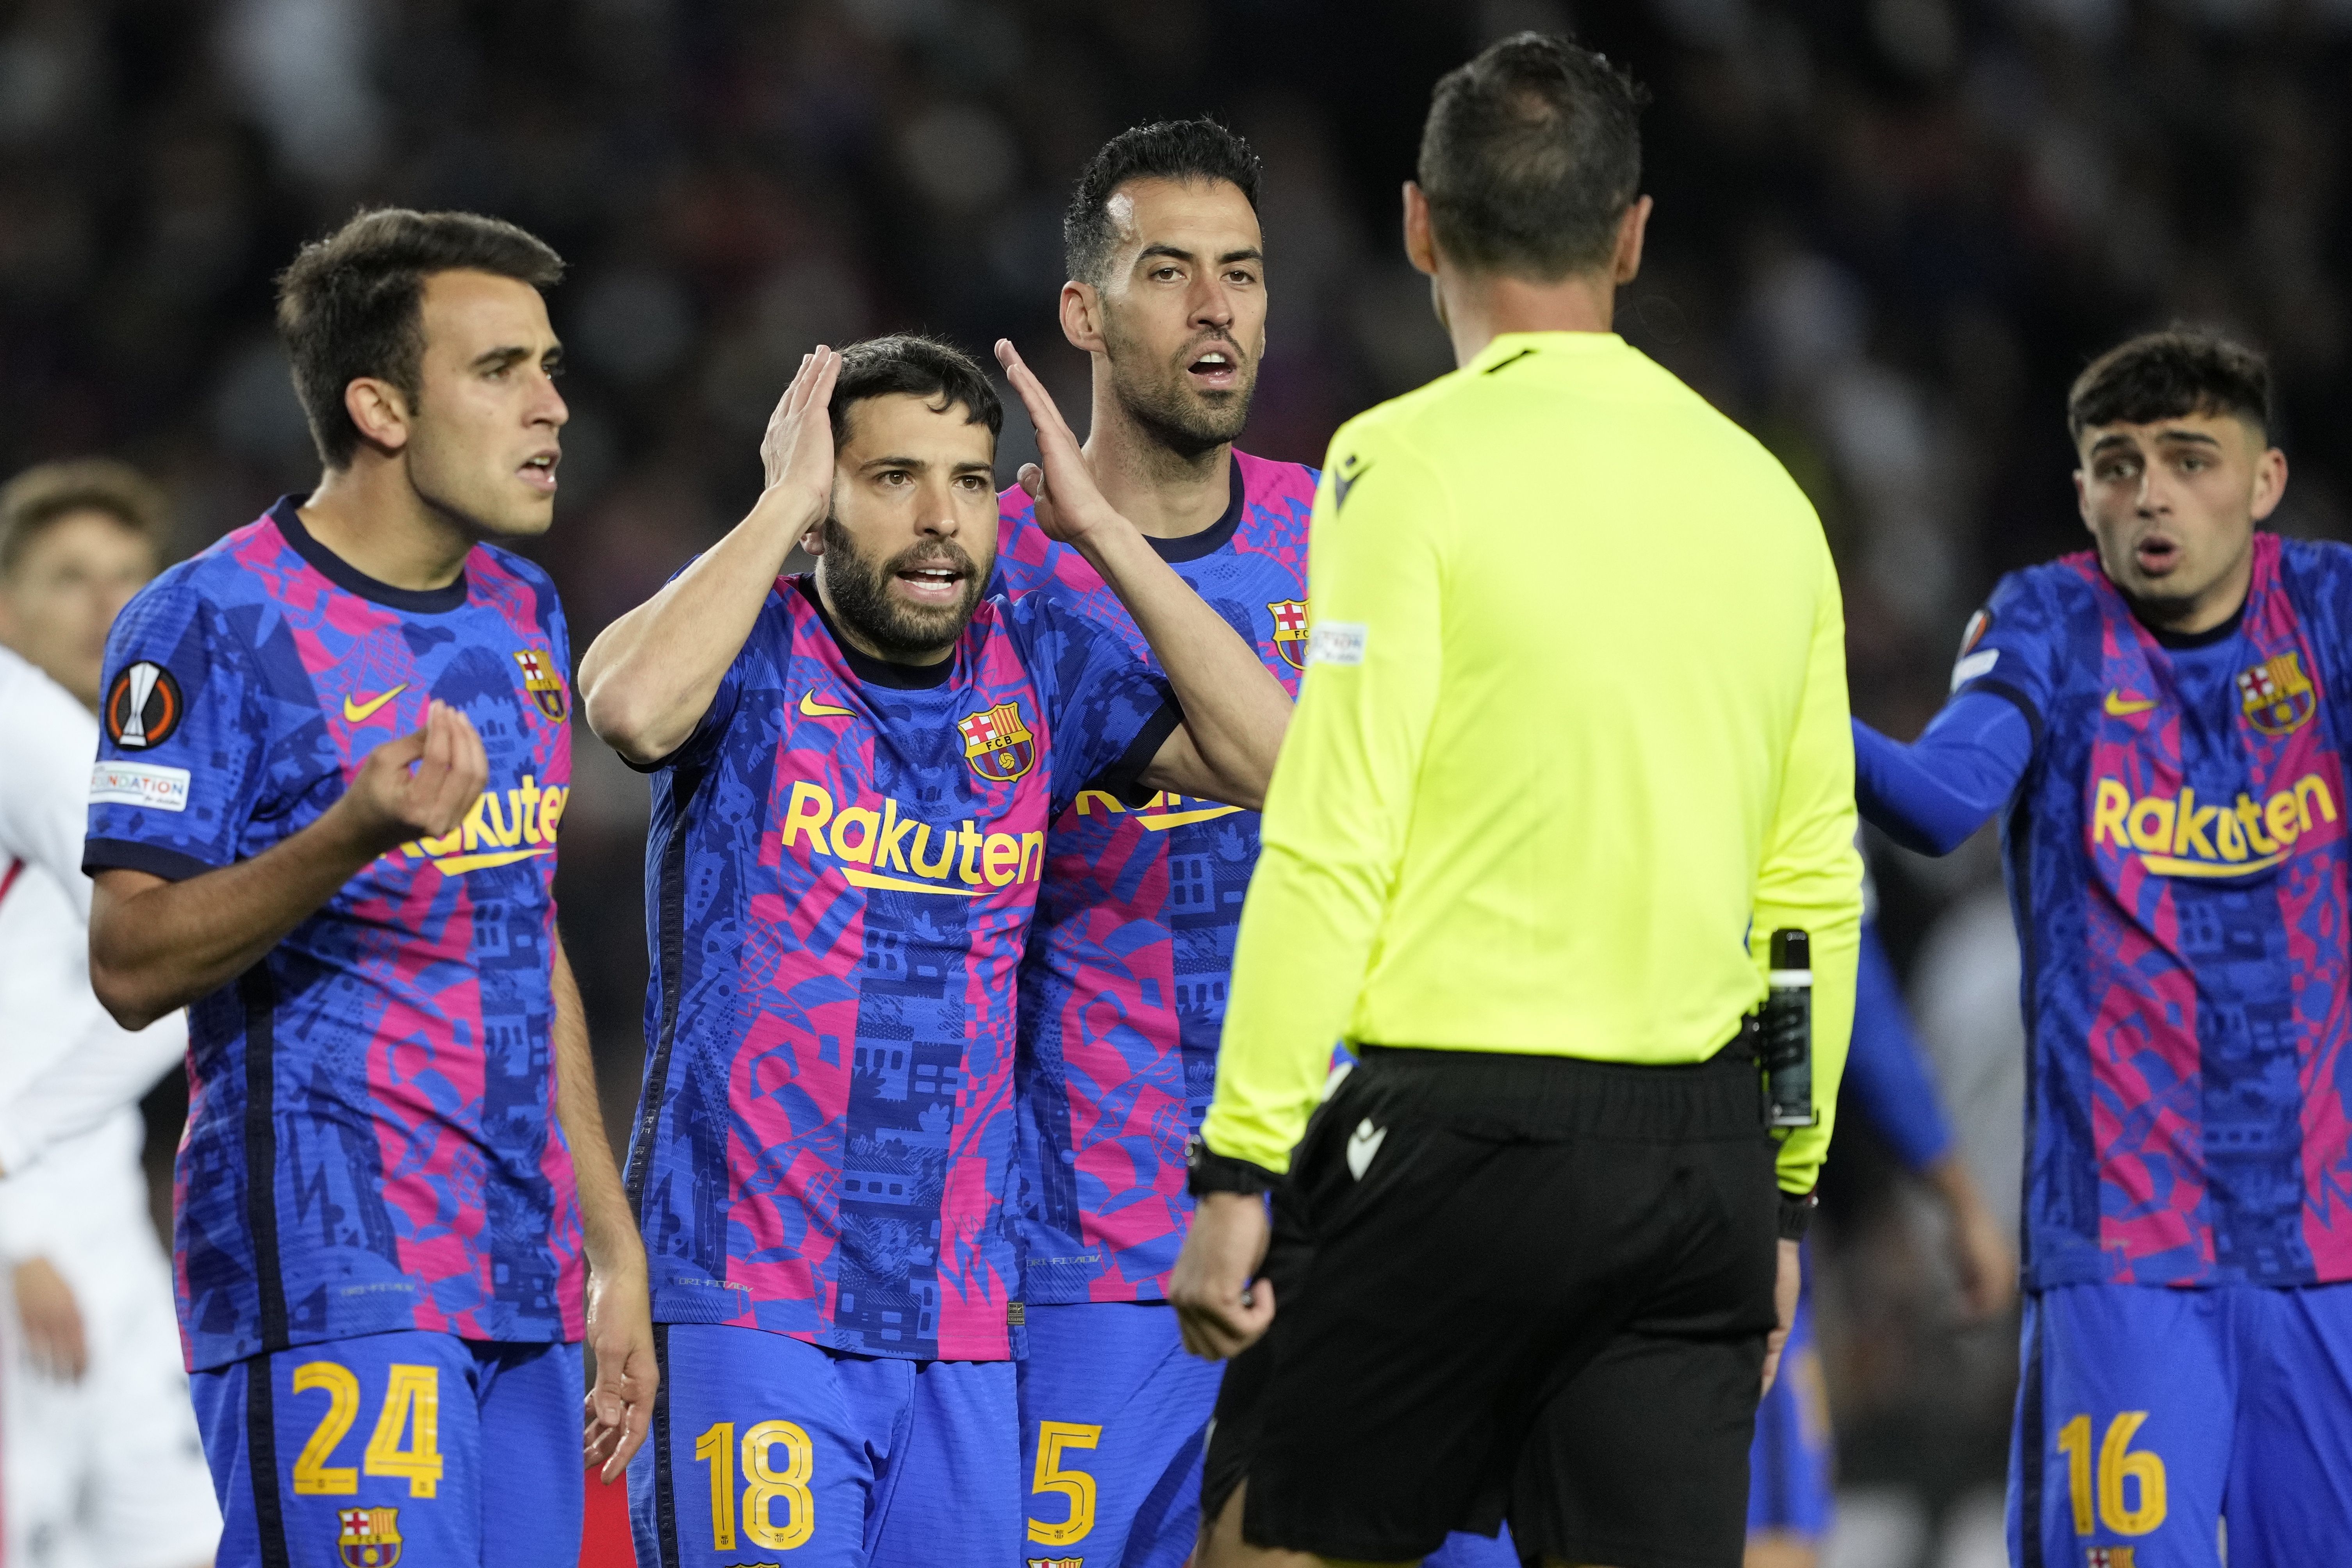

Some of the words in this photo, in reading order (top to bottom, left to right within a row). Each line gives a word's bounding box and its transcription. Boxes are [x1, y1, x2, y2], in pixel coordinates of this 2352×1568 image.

[1294, 630, 1309, 639] FC
[91, 775, 184, 794] FNDATION
[986, 736, 1012, 750] FCB
[379, 774, 569, 857] kute
[782, 780, 1044, 886] Rakuten
[2093, 773, 2337, 860] Rakuten
[292, 1361, 443, 1499] 24
[2058, 1410, 2167, 1536] 16
[695, 1419, 814, 1550] 18
[1027, 1420, 1102, 1546] 5
